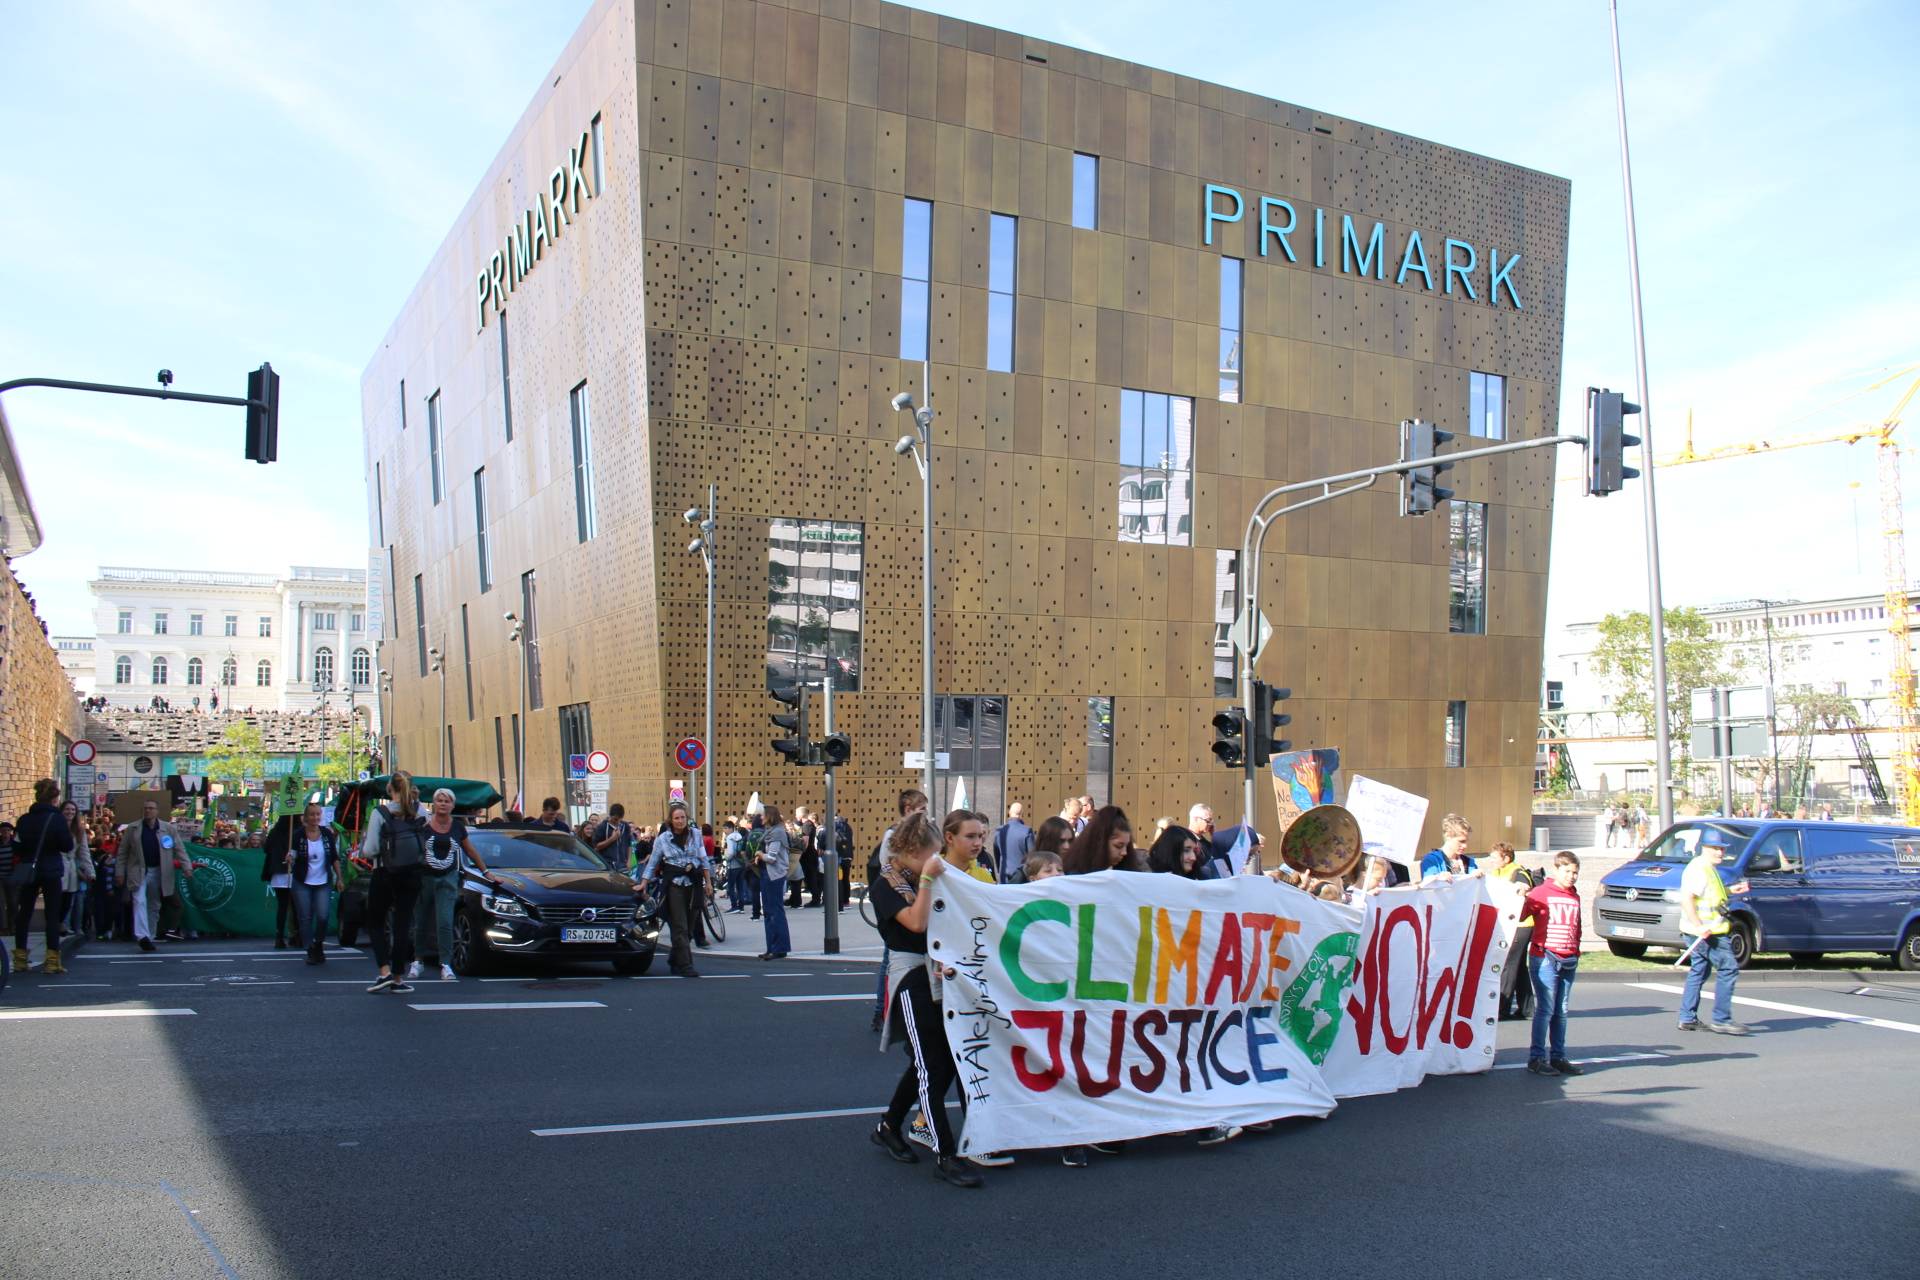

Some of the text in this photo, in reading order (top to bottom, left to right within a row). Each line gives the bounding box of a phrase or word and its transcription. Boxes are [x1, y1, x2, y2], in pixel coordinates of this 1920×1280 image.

[477, 132, 592, 328] PRIMARK
[1203, 183, 1522, 309] PRIMARK
[1277, 790, 1291, 803] No
[212, 859, 234, 887] FUTURE
[567, 929, 577, 940] RS
[1000, 899, 1301, 1006] CLIMATE
[1300, 950, 1325, 984] FOR
[1347, 904, 1499, 1056] NOW!
[1011, 1006, 1288, 1098] JUSTICE
